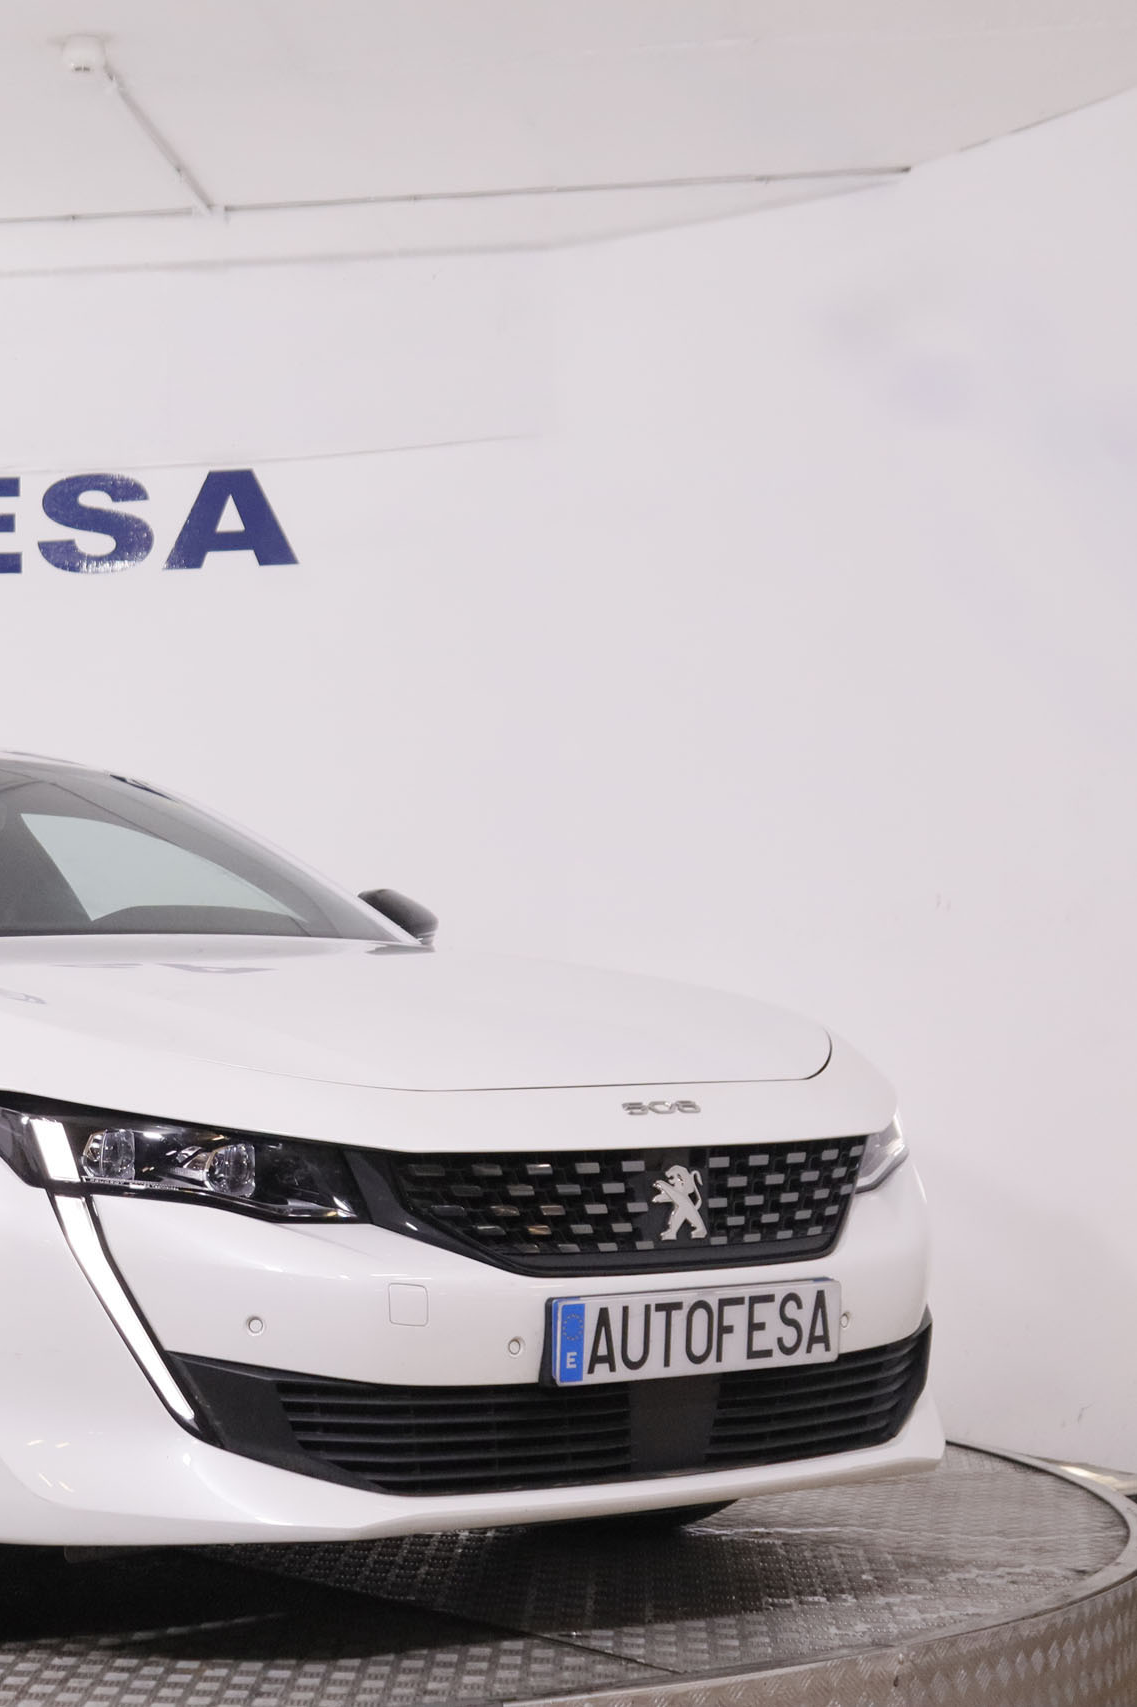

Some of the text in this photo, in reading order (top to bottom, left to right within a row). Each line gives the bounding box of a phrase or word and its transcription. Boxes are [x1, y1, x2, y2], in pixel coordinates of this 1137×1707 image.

[622, 1100, 701, 1115] 508
[587, 1290, 831, 1375] AUTOFESA
[566, 1352, 577, 1369] E
